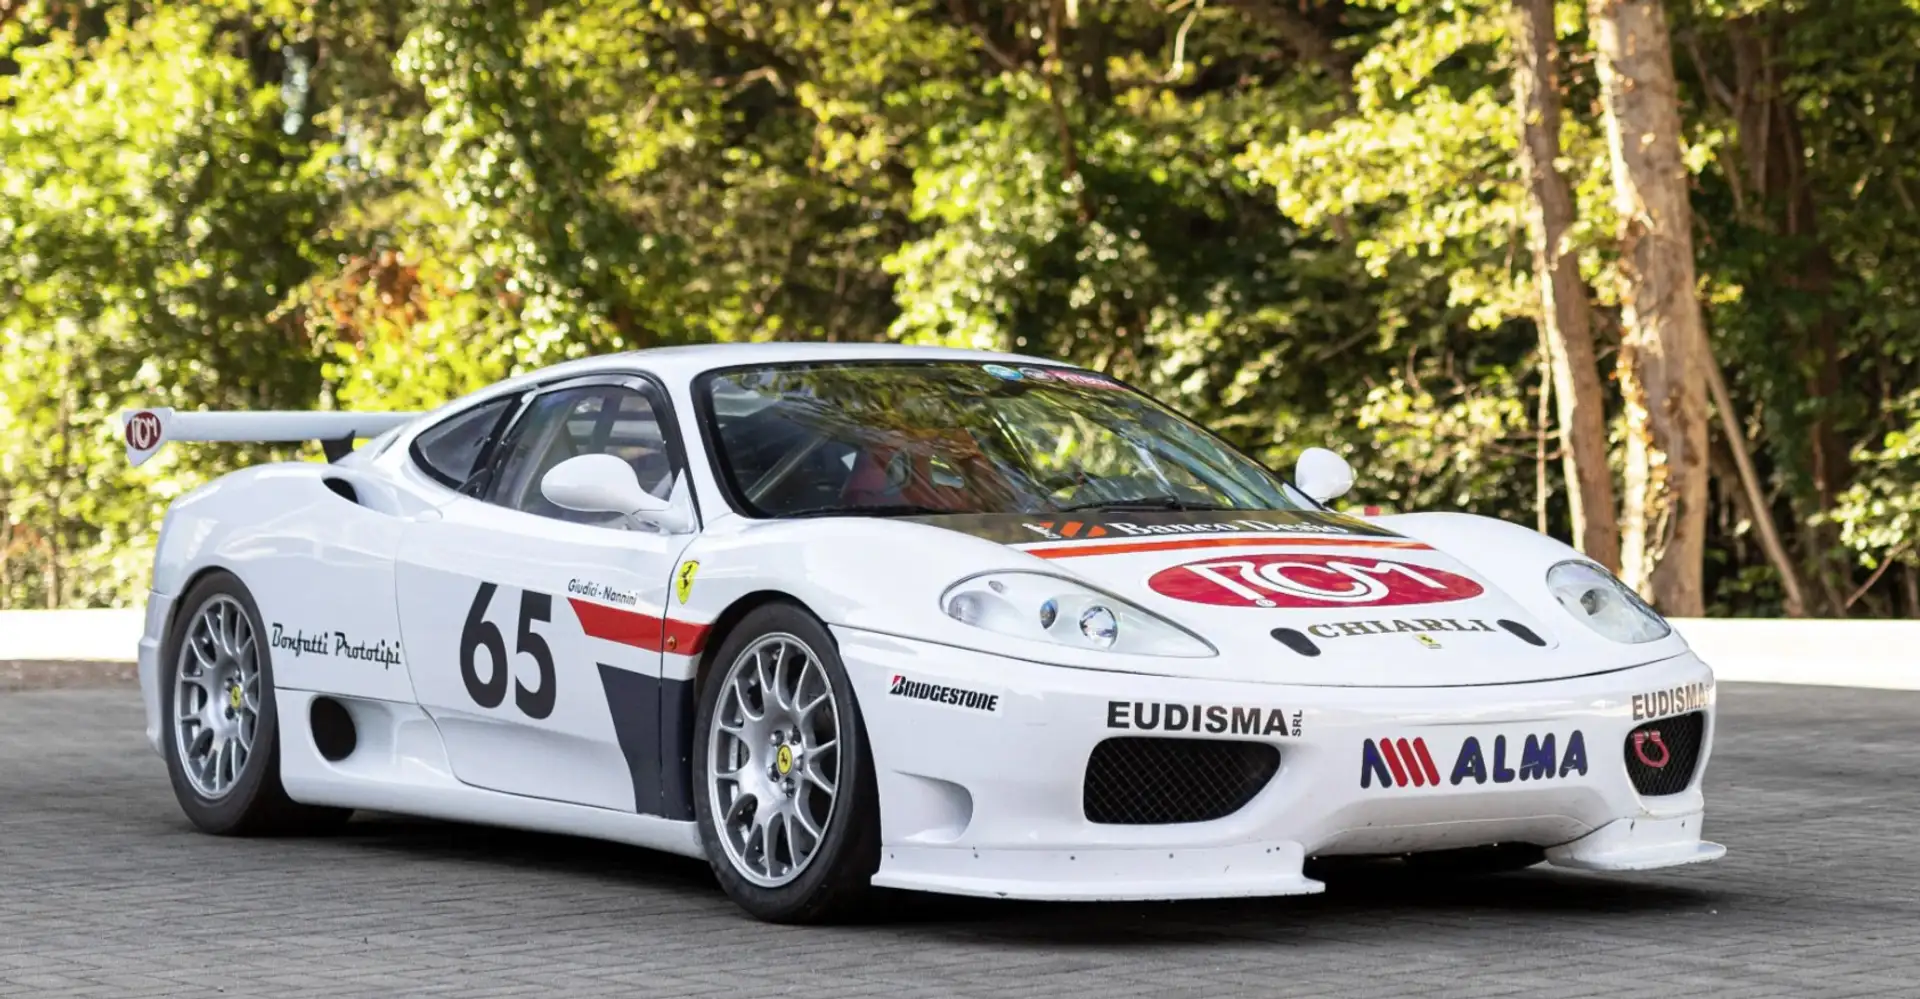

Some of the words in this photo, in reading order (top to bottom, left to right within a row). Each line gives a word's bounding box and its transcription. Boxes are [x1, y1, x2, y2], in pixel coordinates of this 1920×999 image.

[1105, 522, 1240, 536] Banco
[1232, 519, 1349, 534] Desio
[568, 578, 598, 597] Giudici
[603, 586, 638, 606] Nannini
[271, 622, 328, 657] Bonfatti
[334, 631, 401, 670] Prototipi
[1308, 619, 1496, 638] CHIARLI
[460, 581, 556, 720] 65
[1107, 701, 1289, 737] EUDISMA
[1291, 709, 1303, 738] SRL
[1632, 682, 1707, 721] EUDISMA
[1450, 730, 1588, 786] ALMA
